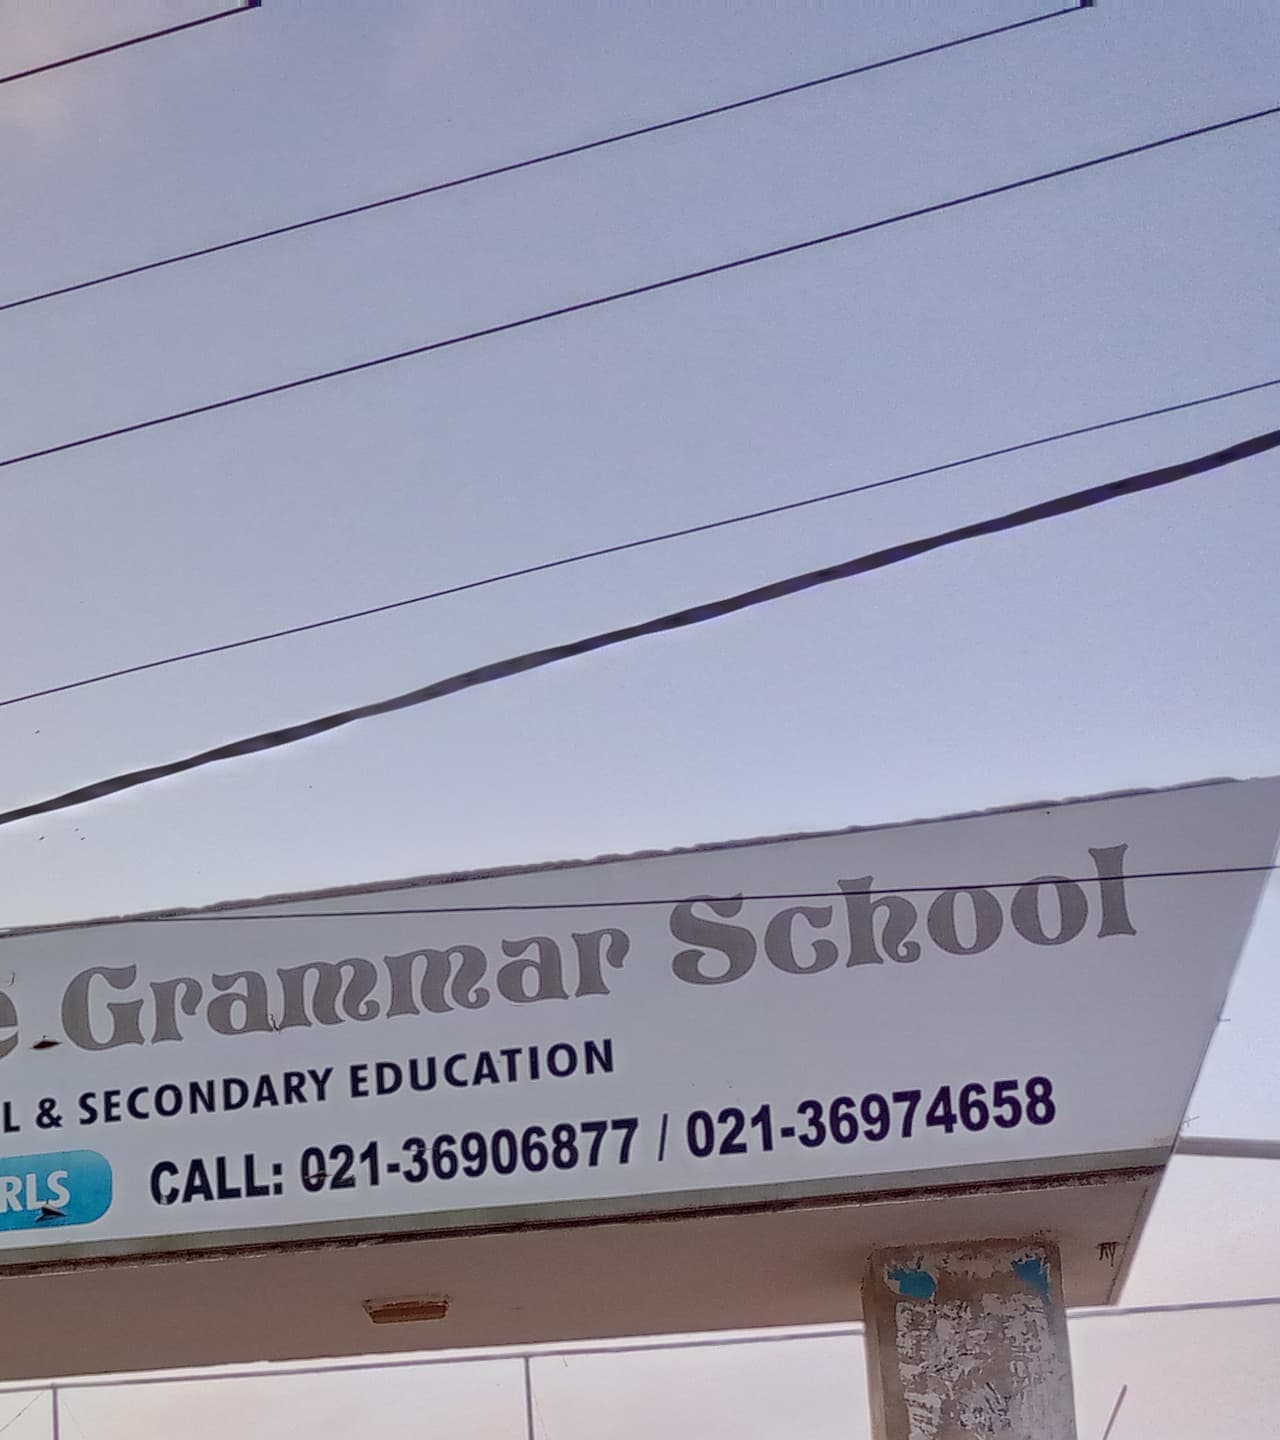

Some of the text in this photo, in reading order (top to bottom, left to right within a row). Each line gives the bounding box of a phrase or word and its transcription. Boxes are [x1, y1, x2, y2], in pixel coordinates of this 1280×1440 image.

[61, 927, 631, 1052] Grammar
[669, 844, 1138, 986] School
[35, 1096, 64, 1129] &
[79, 1067, 334, 1127] SECONDARY
[350, 1038, 615, 1098] EDUCATION
[149, 1075, 1057, 1206] CALL: 021-36906877 / 021-36974658
